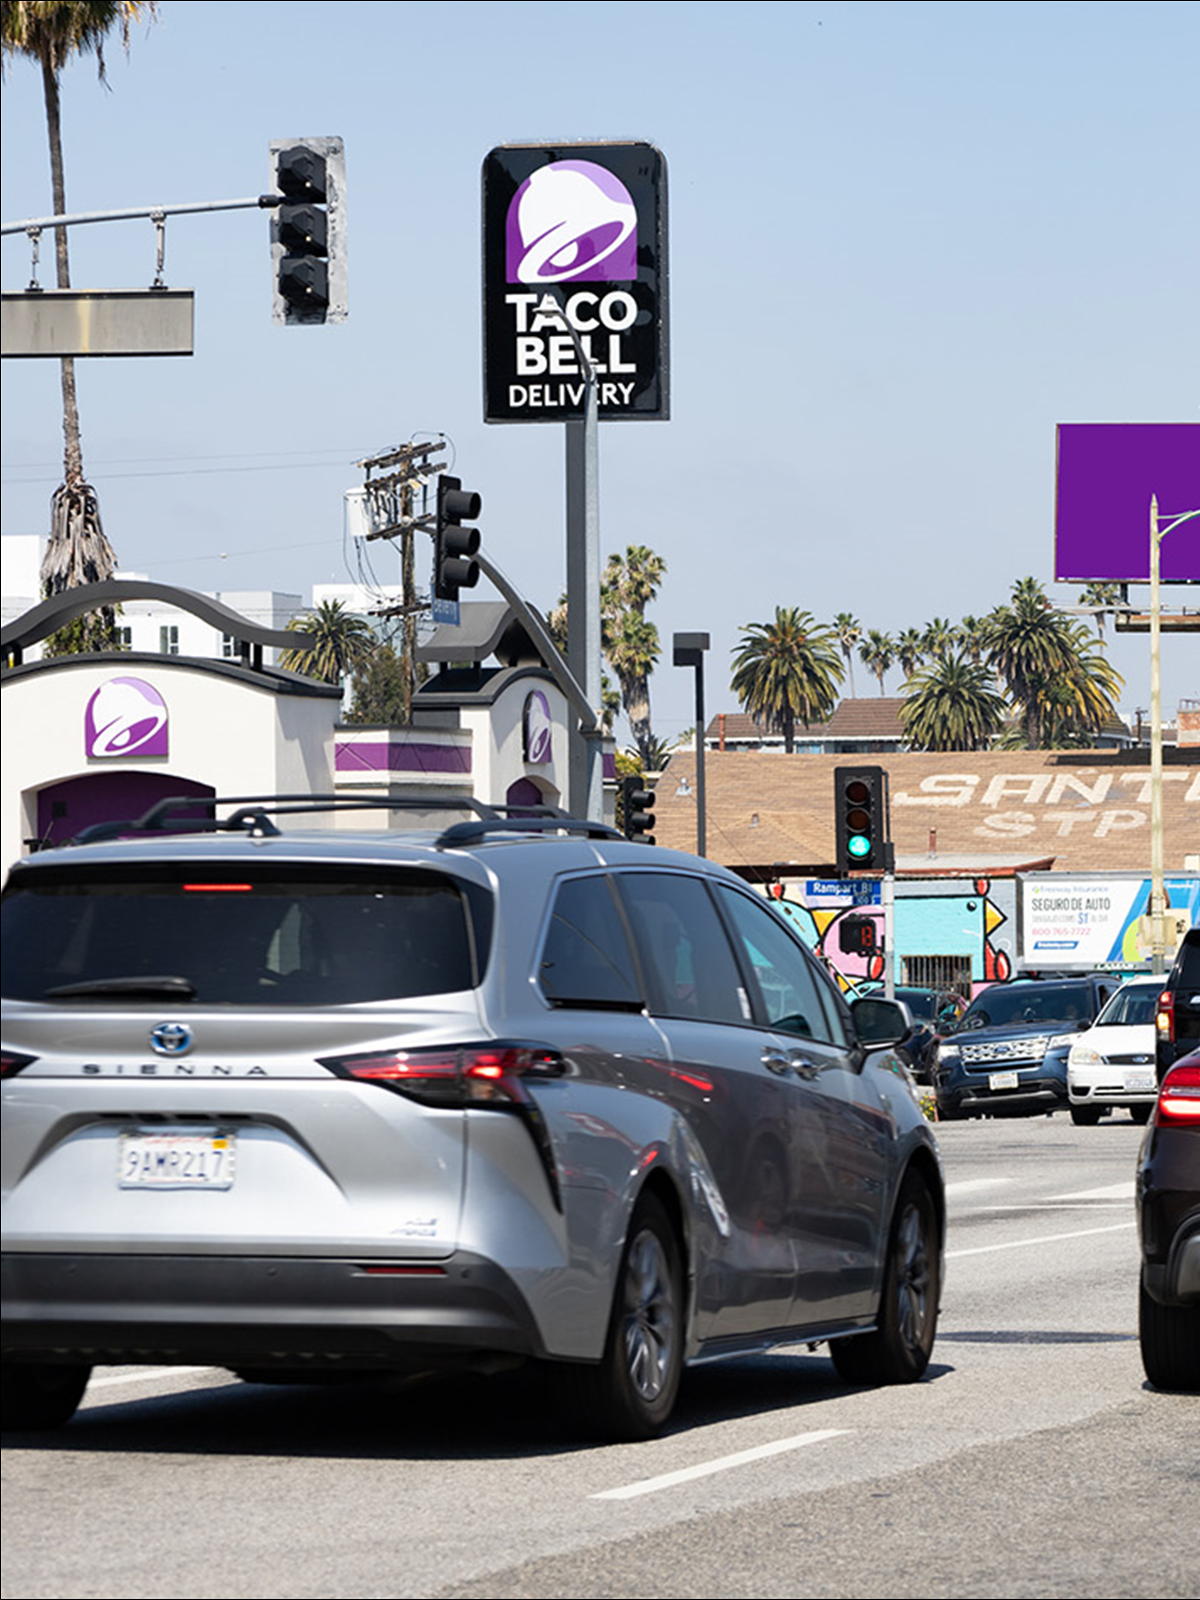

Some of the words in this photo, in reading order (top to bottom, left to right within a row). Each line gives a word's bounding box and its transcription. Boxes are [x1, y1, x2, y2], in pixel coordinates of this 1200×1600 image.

[505, 290, 638, 332] TACO
[516, 334, 637, 376] BELL
[509, 382, 636, 408] DELIVRY
[973, 809, 1148, 838] STP
[812, 881, 857, 896] Rampart
[1031, 897, 1070, 911] SEGURO
[1071, 897, 1083, 911] DE
[1085, 897, 1111, 911] AUTO
[861, 925, 873, 947] 13
[82, 1064, 267, 1076] SIENNA
